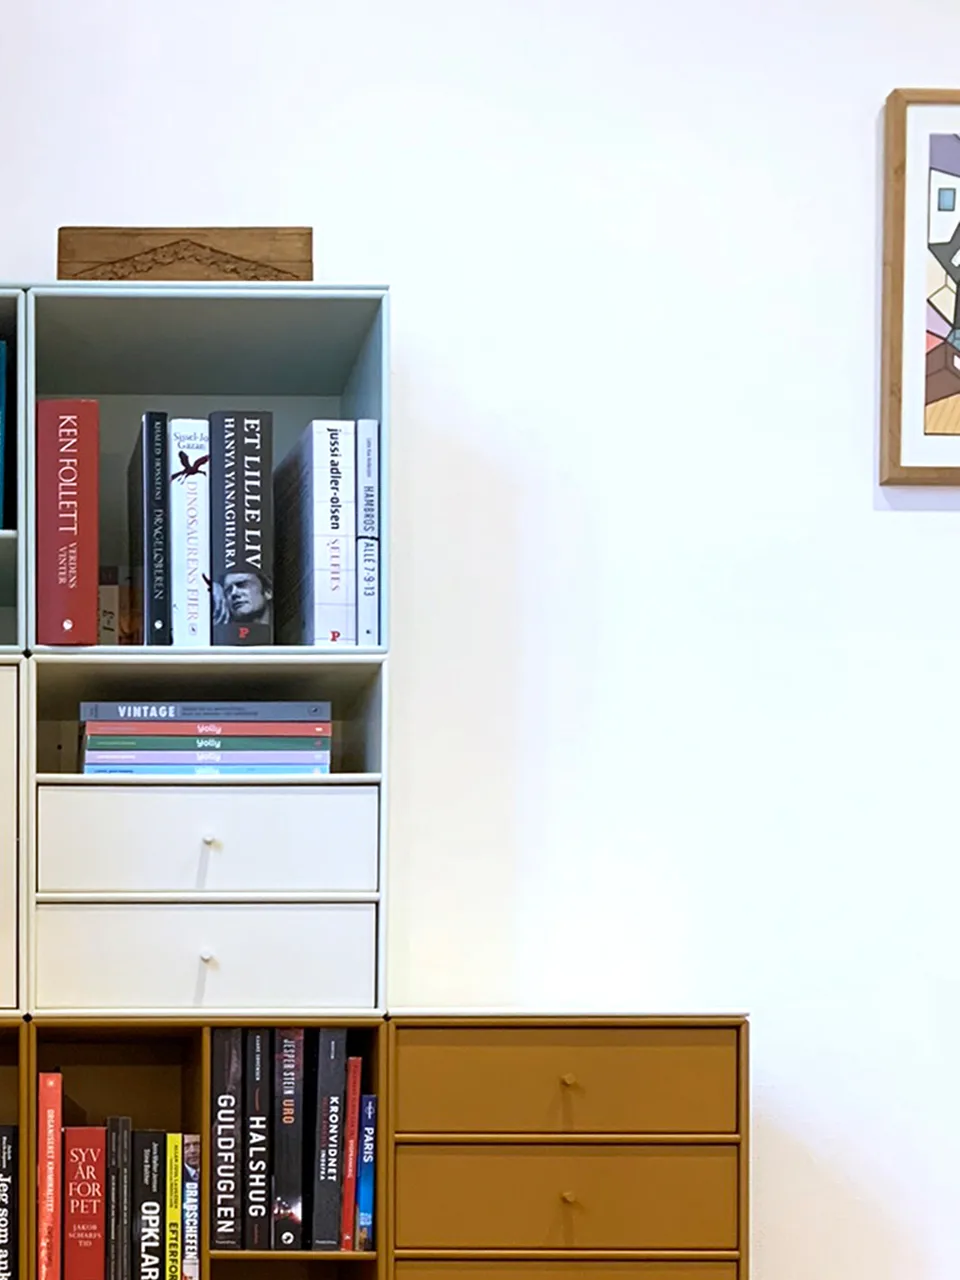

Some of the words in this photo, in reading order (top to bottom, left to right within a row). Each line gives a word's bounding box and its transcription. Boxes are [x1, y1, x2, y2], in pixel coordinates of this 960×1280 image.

[58, 415, 78, 453] KEN
[224, 418, 236, 468] HANYA
[244, 417, 261, 449] ET
[326, 427, 342, 457] jussi
[58, 458, 78, 536] FOLLETT
[244, 455, 261, 523] LILLE
[329, 459, 343, 530] adler-olsen
[363, 485, 375, 532] HAMBROS
[186, 481, 199, 584] DINOSAURENS
[224, 470, 236, 569] YANAGIHARA
[57, 545, 67, 584] VINTER
[67, 542, 77, 589] VERDENS
[244, 529, 261, 569] LIV
[118, 705, 176, 718] VINTAGE
[283, 1039, 295, 1069] JESPER
[283, 1071, 295, 1095] STEIN
[282, 1099, 295, 1124] URO
[70, 1148, 101, 1162] SYV
[327, 1096, 339, 1182] KRONVIDNET
[363, 1127, 374, 1163] PARIS
[74, 1161, 97, 1180] ÅR
[217, 1094, 236, 1233] GULDFUGLEN
[248, 1116, 266, 1217] HALSHUG
[68, 1181, 102, 1197] FOR
[70, 1199, 101, 1214] PET
[185, 1182, 198, 1260] DRABSCHEFEN
